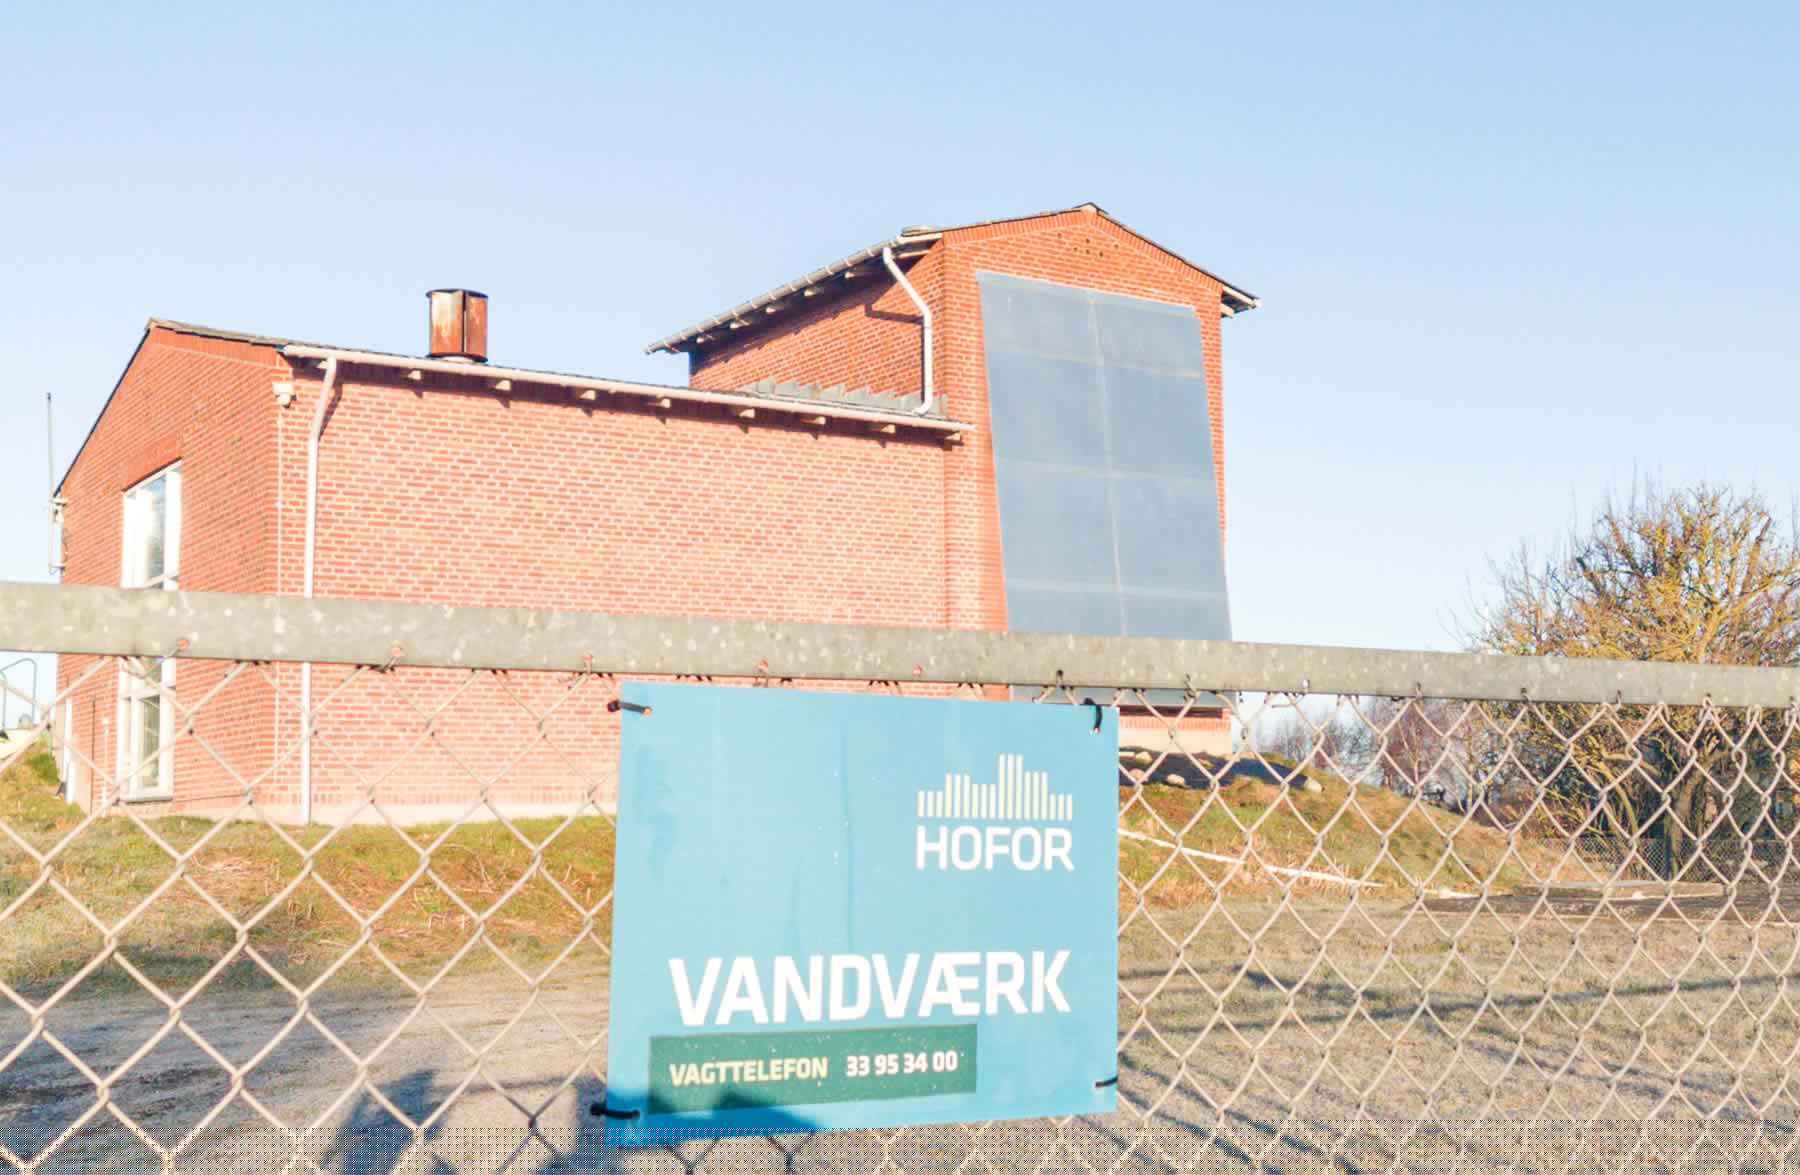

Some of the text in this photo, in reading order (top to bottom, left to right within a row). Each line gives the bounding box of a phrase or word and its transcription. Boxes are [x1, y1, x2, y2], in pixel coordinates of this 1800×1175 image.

[915, 826, 1075, 871] HOFOR
[668, 950, 1073, 1027] VANDVÆRK
[669, 1050, 958, 1086] VAGTTELEFON 33 95 34 00
